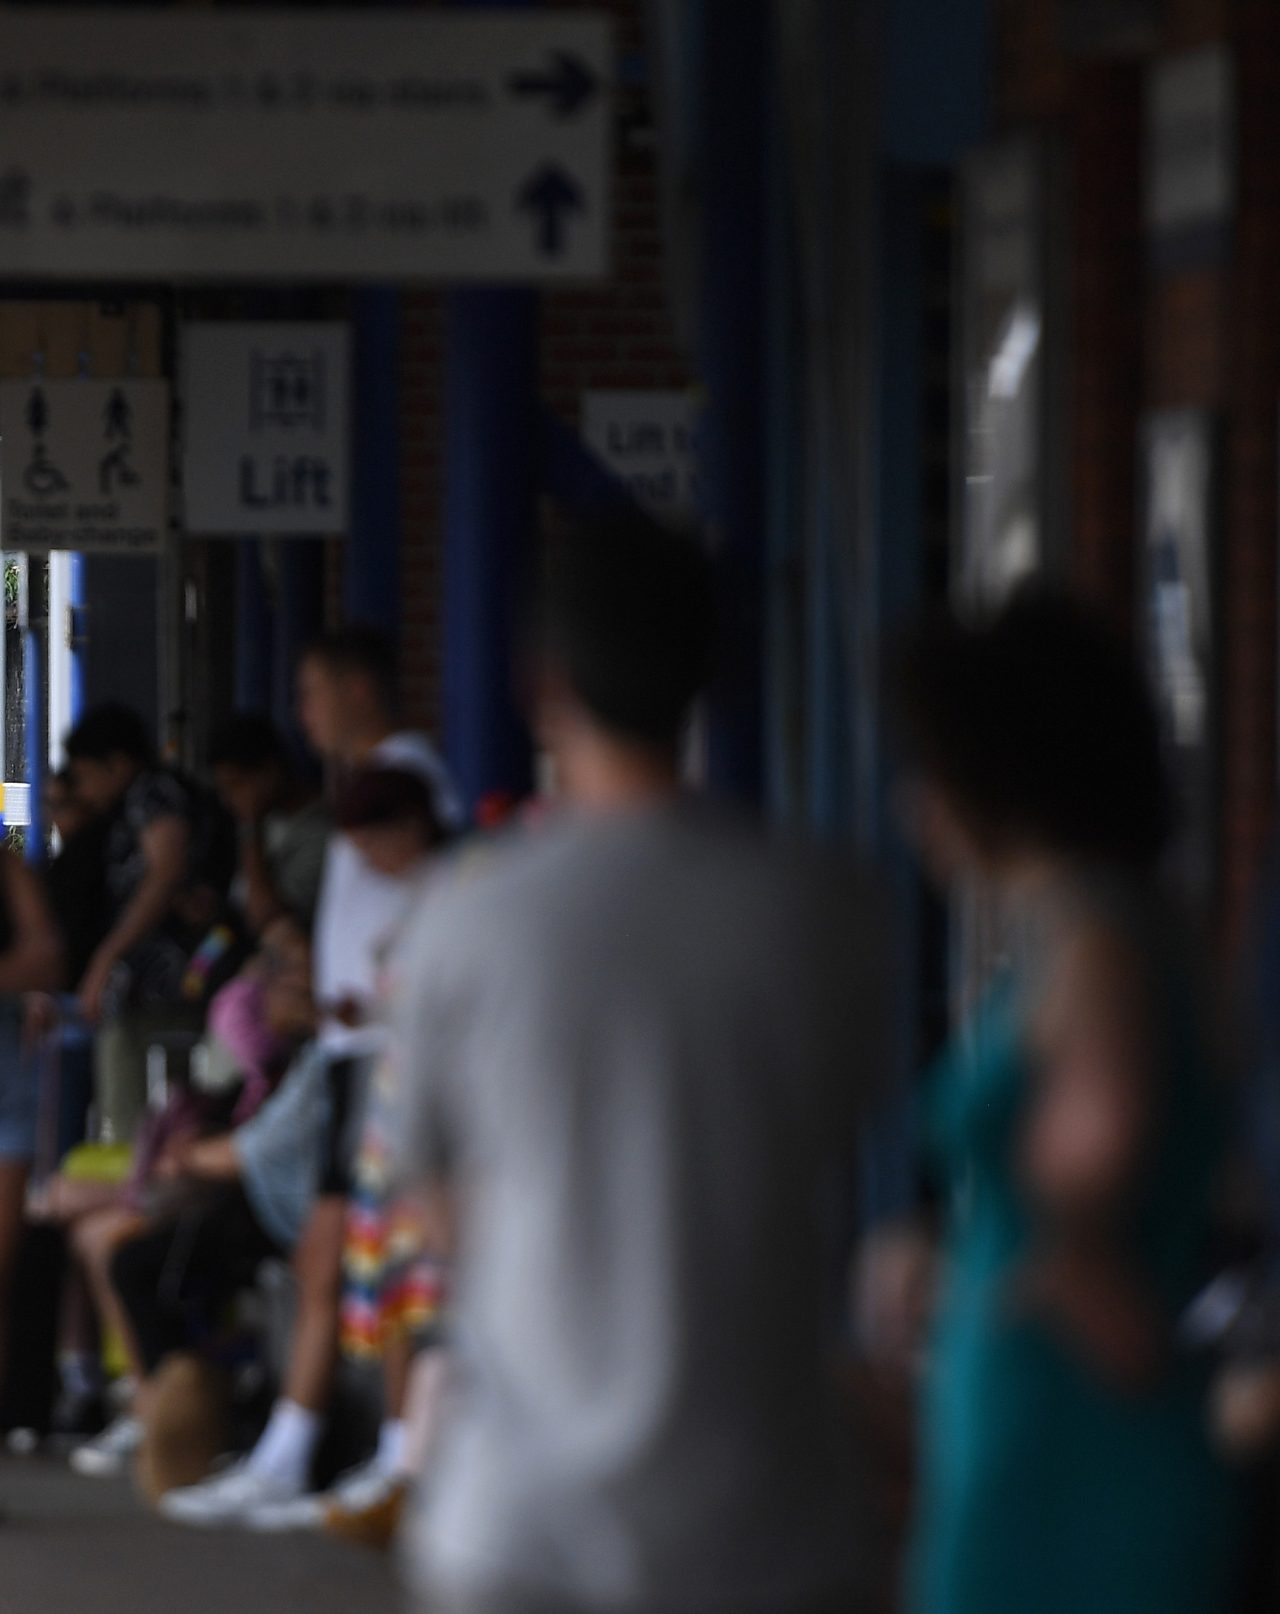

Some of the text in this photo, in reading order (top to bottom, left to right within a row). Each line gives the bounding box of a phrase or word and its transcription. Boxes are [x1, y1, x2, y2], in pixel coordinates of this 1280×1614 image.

[607, 422, 664, 455] Lift
[239, 454, 331, 509] Lift
[76, 499, 120, 519] and
